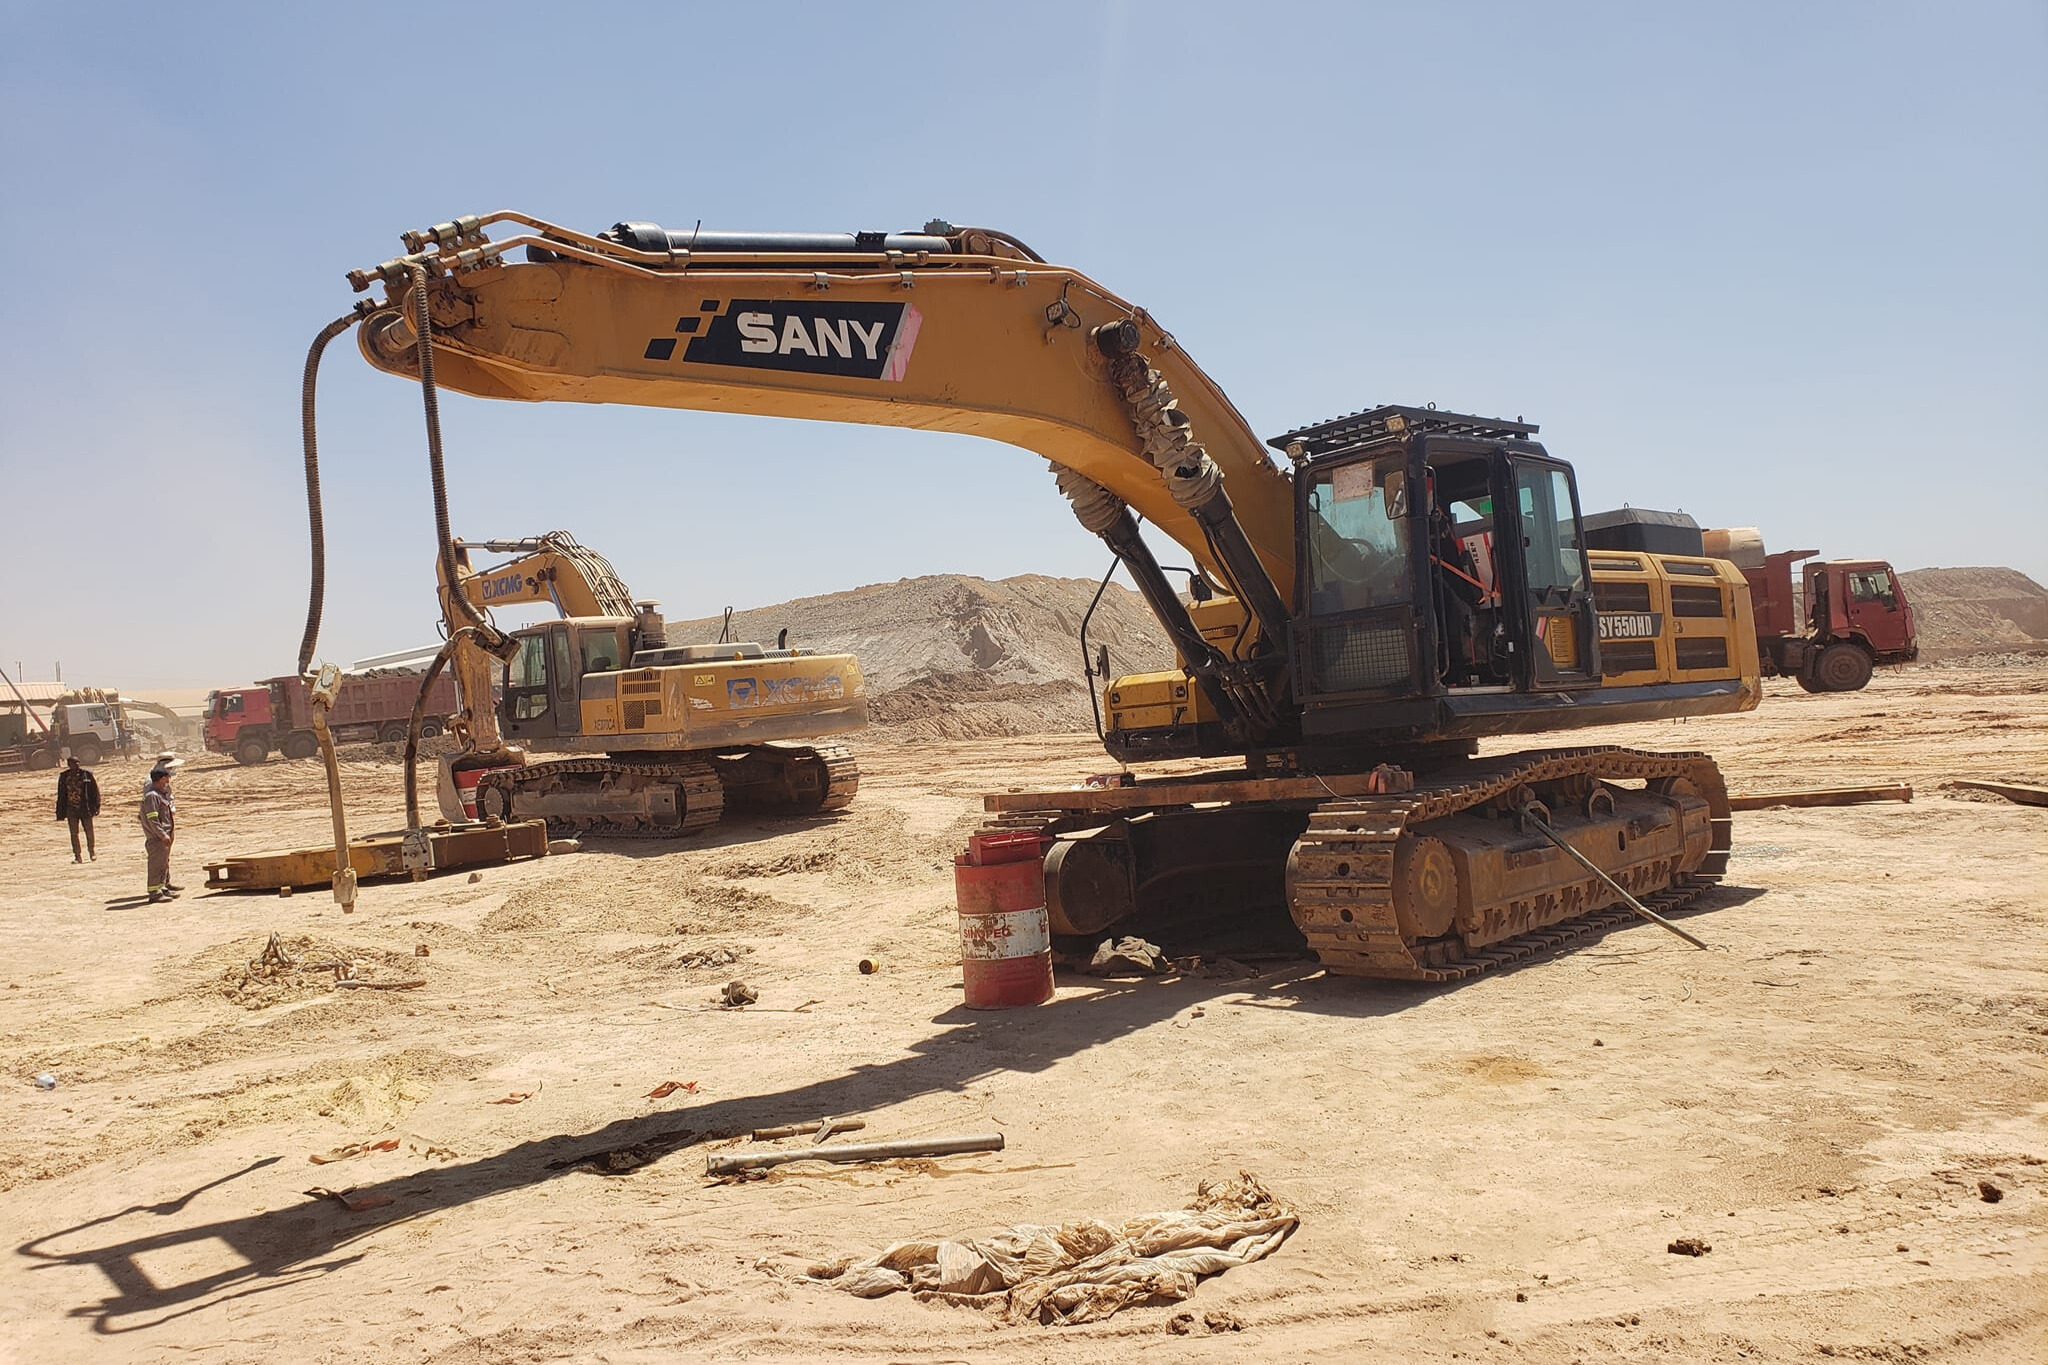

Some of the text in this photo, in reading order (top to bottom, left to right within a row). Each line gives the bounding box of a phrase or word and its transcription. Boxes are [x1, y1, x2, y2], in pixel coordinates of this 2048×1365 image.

[736, 311, 886, 360] SANY
[490, 573, 523, 598] XCMG
[1598, 615, 1653, 638] SY550HD
